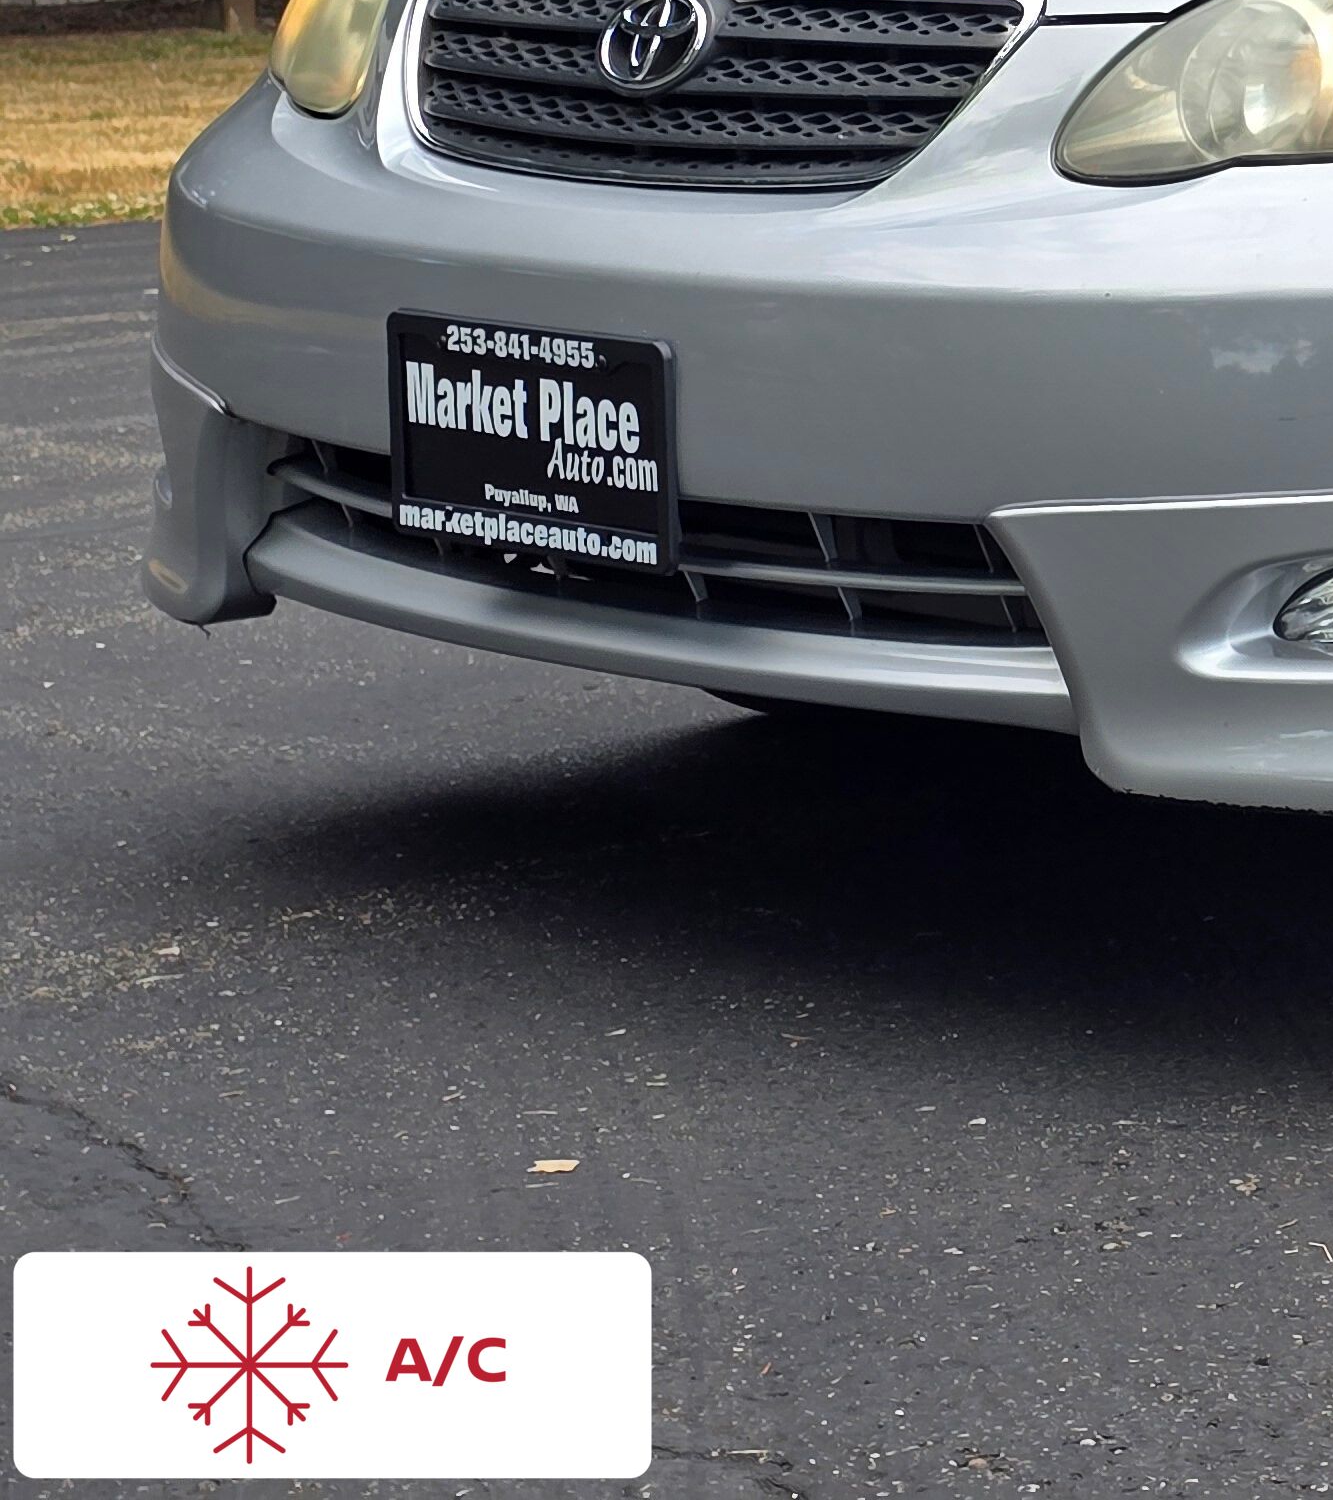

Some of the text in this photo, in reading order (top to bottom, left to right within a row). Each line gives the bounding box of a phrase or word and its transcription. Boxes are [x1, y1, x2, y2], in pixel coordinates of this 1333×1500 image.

[446, 324, 595, 369] 253-841-4955
[405, 361, 640, 454] Market Place
[484, 483, 579, 514] Puyallup, WA
[400, 504, 658, 566] marketplaceauto.com
